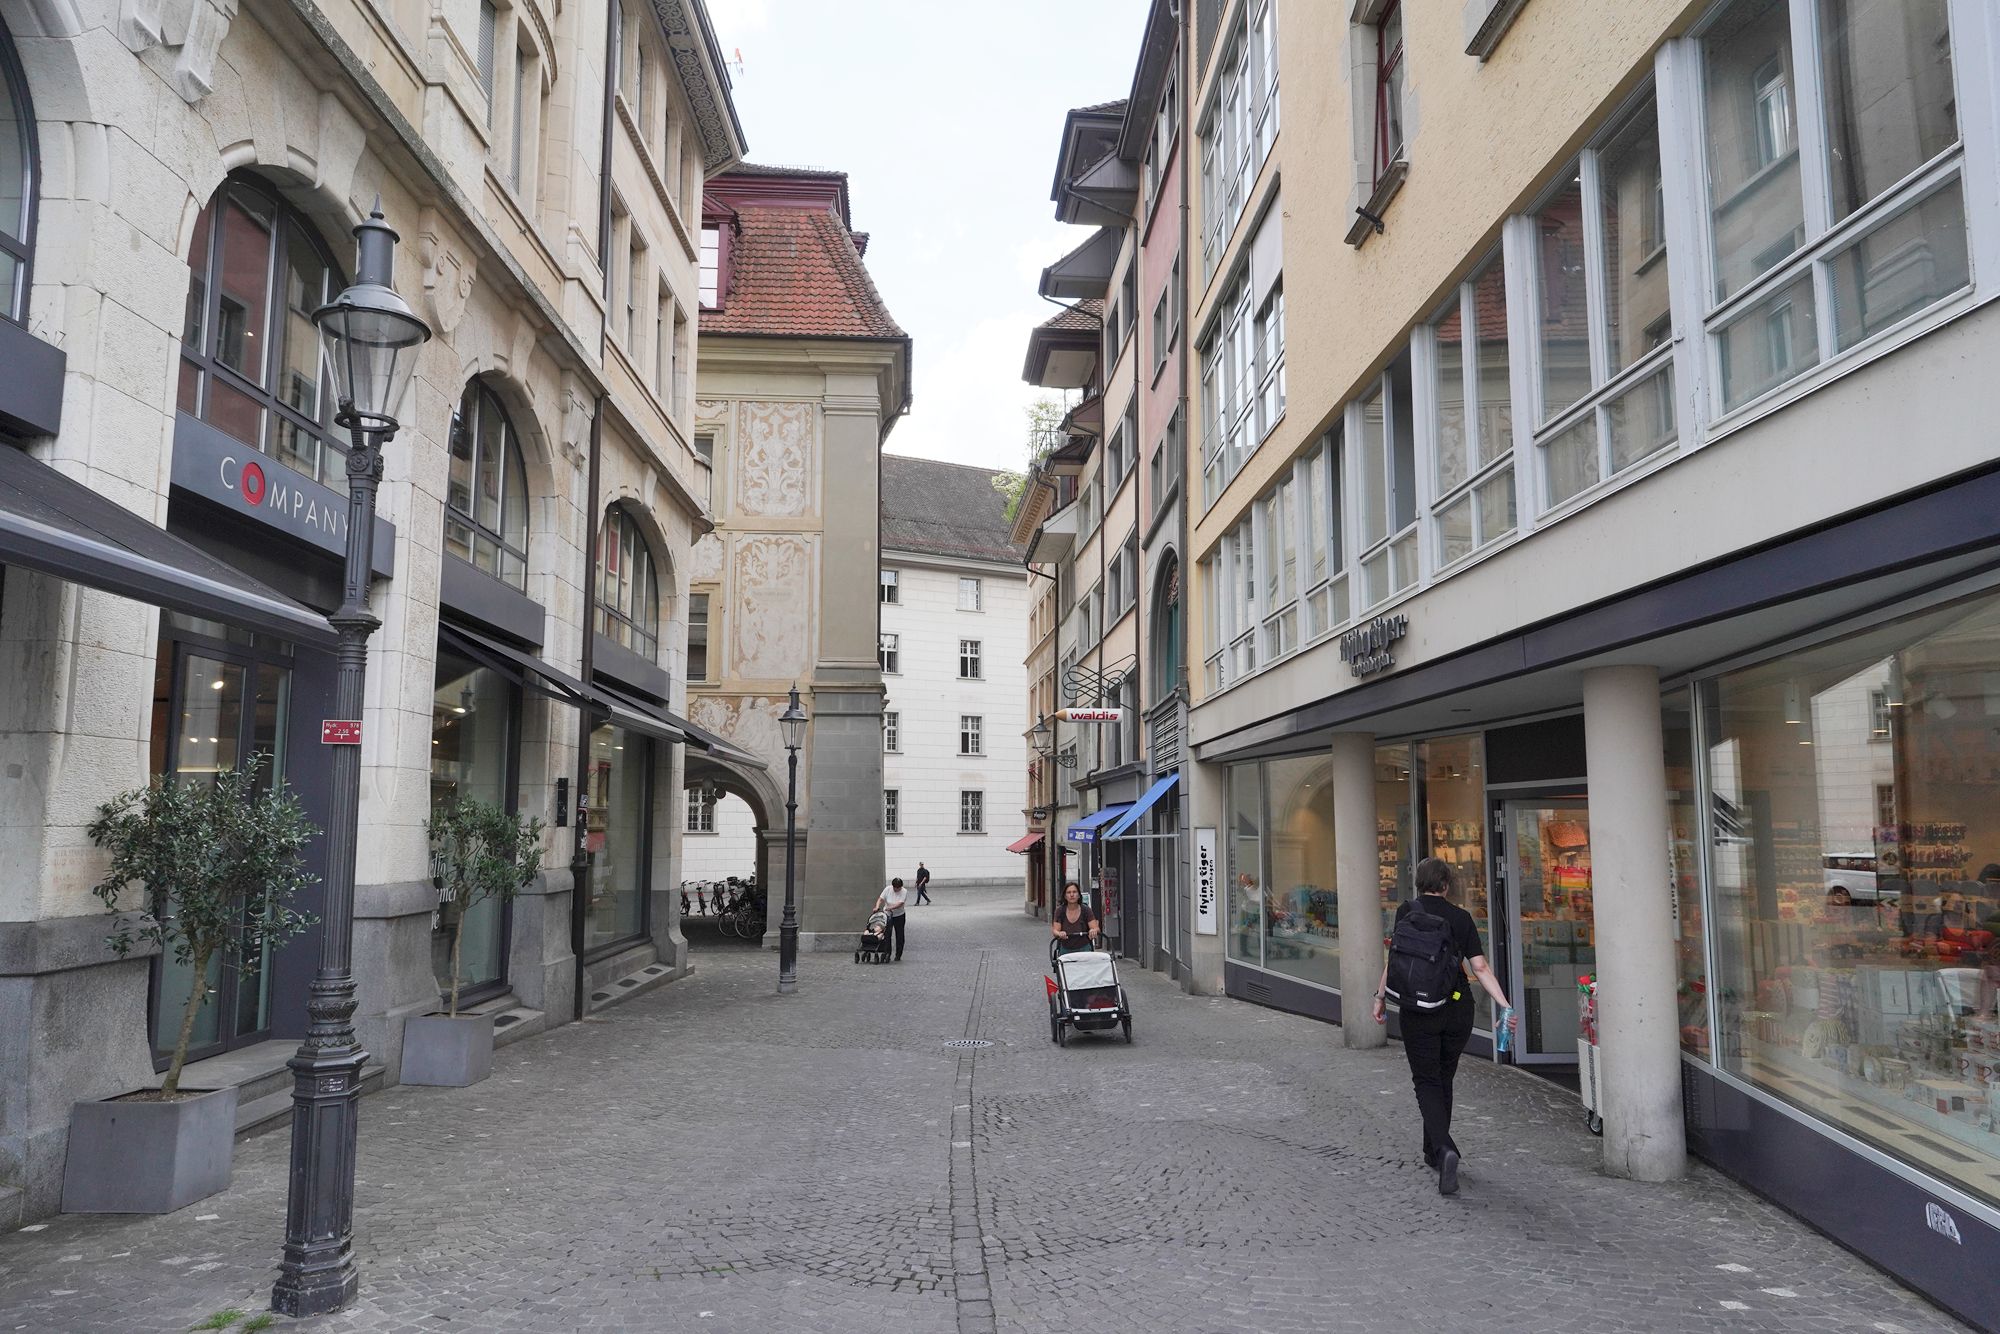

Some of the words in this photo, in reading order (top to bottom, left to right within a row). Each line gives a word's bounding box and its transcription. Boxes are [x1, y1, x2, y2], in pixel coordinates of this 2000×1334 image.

[220, 456, 348, 542] COMPANY
[1070, 711, 1119, 721] waldis
[1199, 845, 1209, 877] tiger
[1199, 879, 1210, 915] flying
